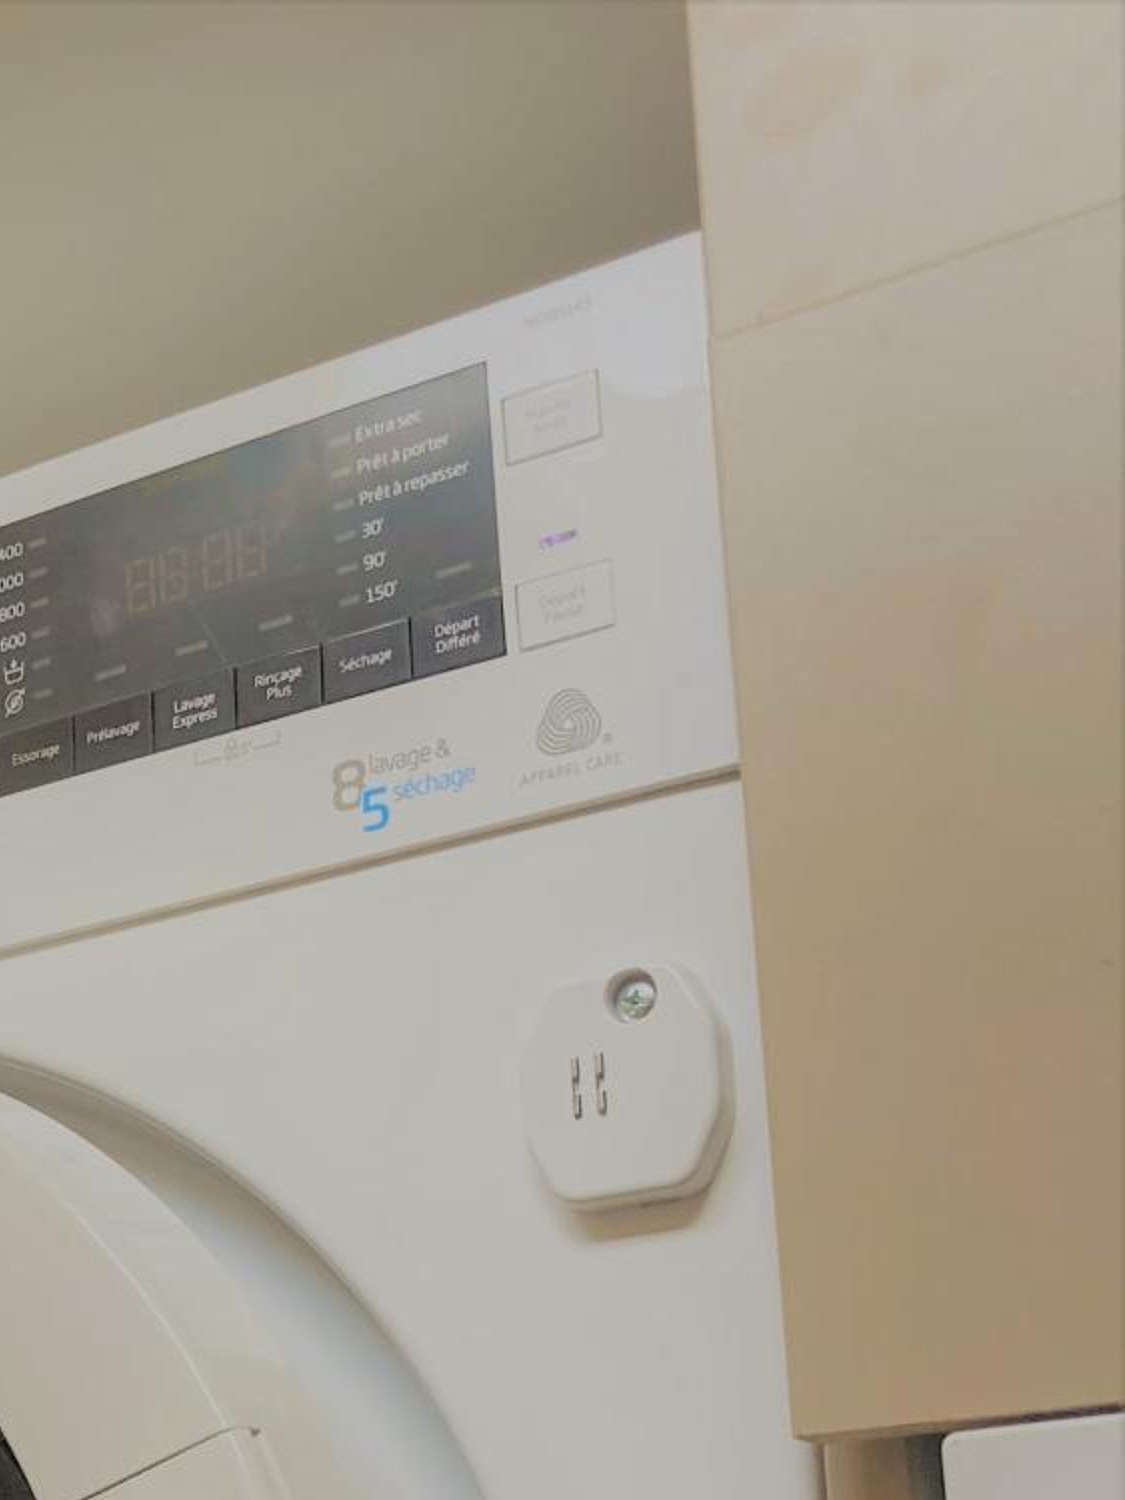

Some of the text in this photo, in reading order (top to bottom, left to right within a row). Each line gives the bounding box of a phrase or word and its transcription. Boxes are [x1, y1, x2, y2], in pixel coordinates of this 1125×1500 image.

[356, 408, 424, 442] Extra sec
[356, 451, 388, 475] Prêt
[403, 431, 451, 465] porter
[358, 481, 392, 507] Prêt
[404, 459, 471, 494] repasser
[435, 613, 481, 639] Départ
[0, 631, 27, 653] 600
[435, 629, 481, 655] Différé
[338, 647, 393, 674] Séchage
[254, 665, 303, 690] Rinçage
[173, 691, 217, 714] Lavage
[266, 683, 294, 702] Plus
[86, 718, 141, 745] Prélavage
[171, 706, 219, 731] Express
[11, 742, 60, 767] Essorage
[368, 736, 453, 776] lavage &
[332, 759, 365, 813] 8
[392, 767, 477, 802] séchage
[362, 785, 392, 833] 5
